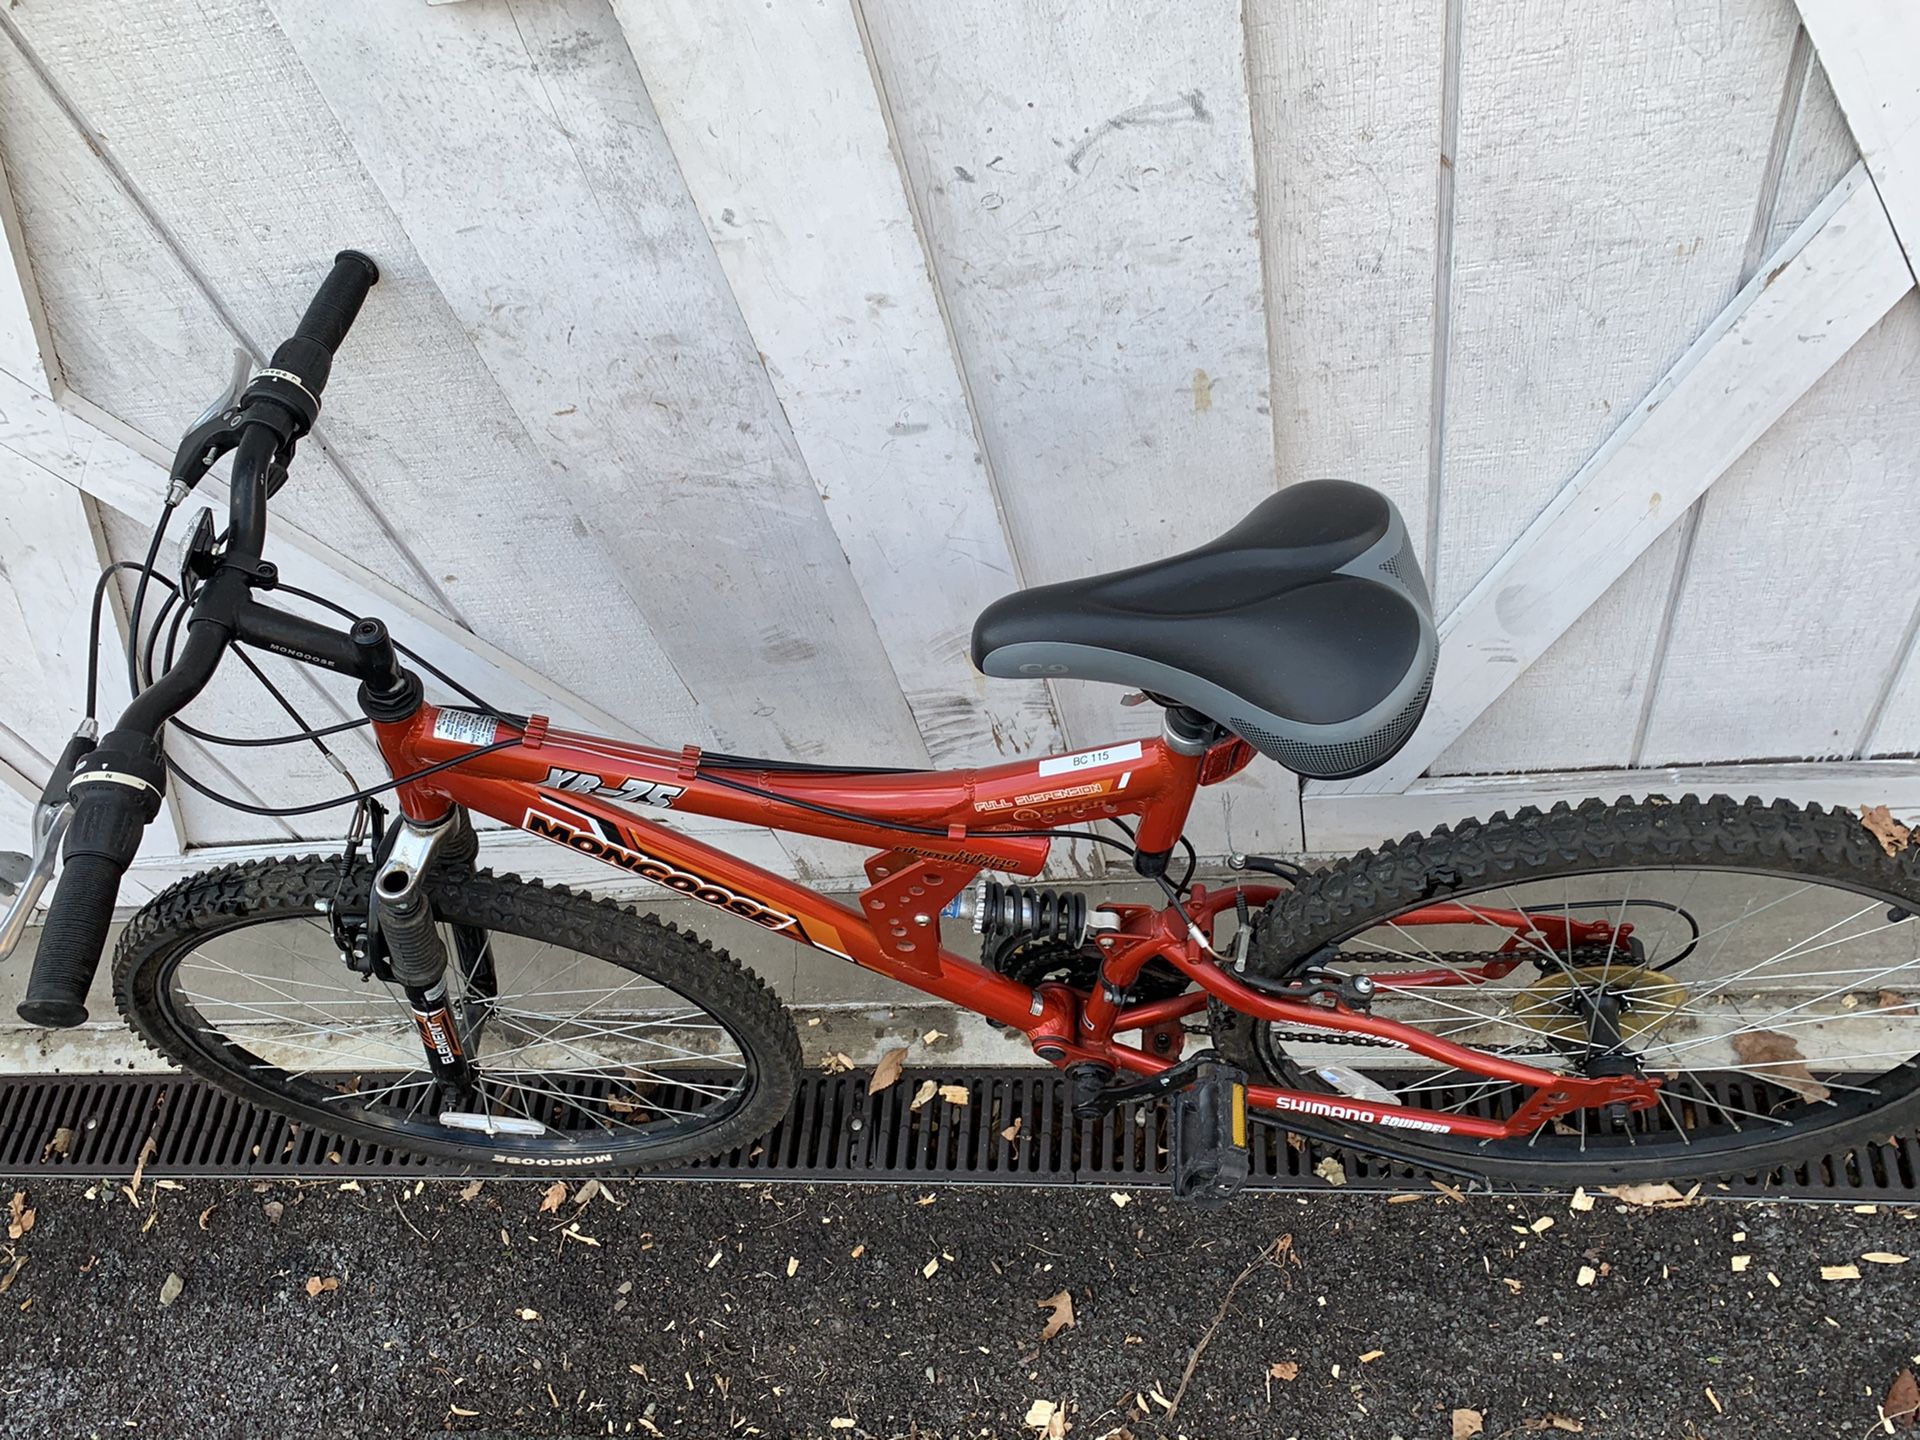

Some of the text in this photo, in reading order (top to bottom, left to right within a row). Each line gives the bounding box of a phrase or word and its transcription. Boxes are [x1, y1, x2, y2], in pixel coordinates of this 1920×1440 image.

[270, 644, 336, 667] MONGOOSE
[1073, 751, 1109, 766] BC 115
[540, 767, 687, 808] XR-75
[974, 784, 1103, 812] FULL SUSPENSION
[525, 811, 791, 928] MONGOOSE
[427, 1021, 455, 1065] ELEMENT
[1276, 1096, 1375, 1123] SHIMANO
[491, 1153, 613, 1167] MONGOOSE
